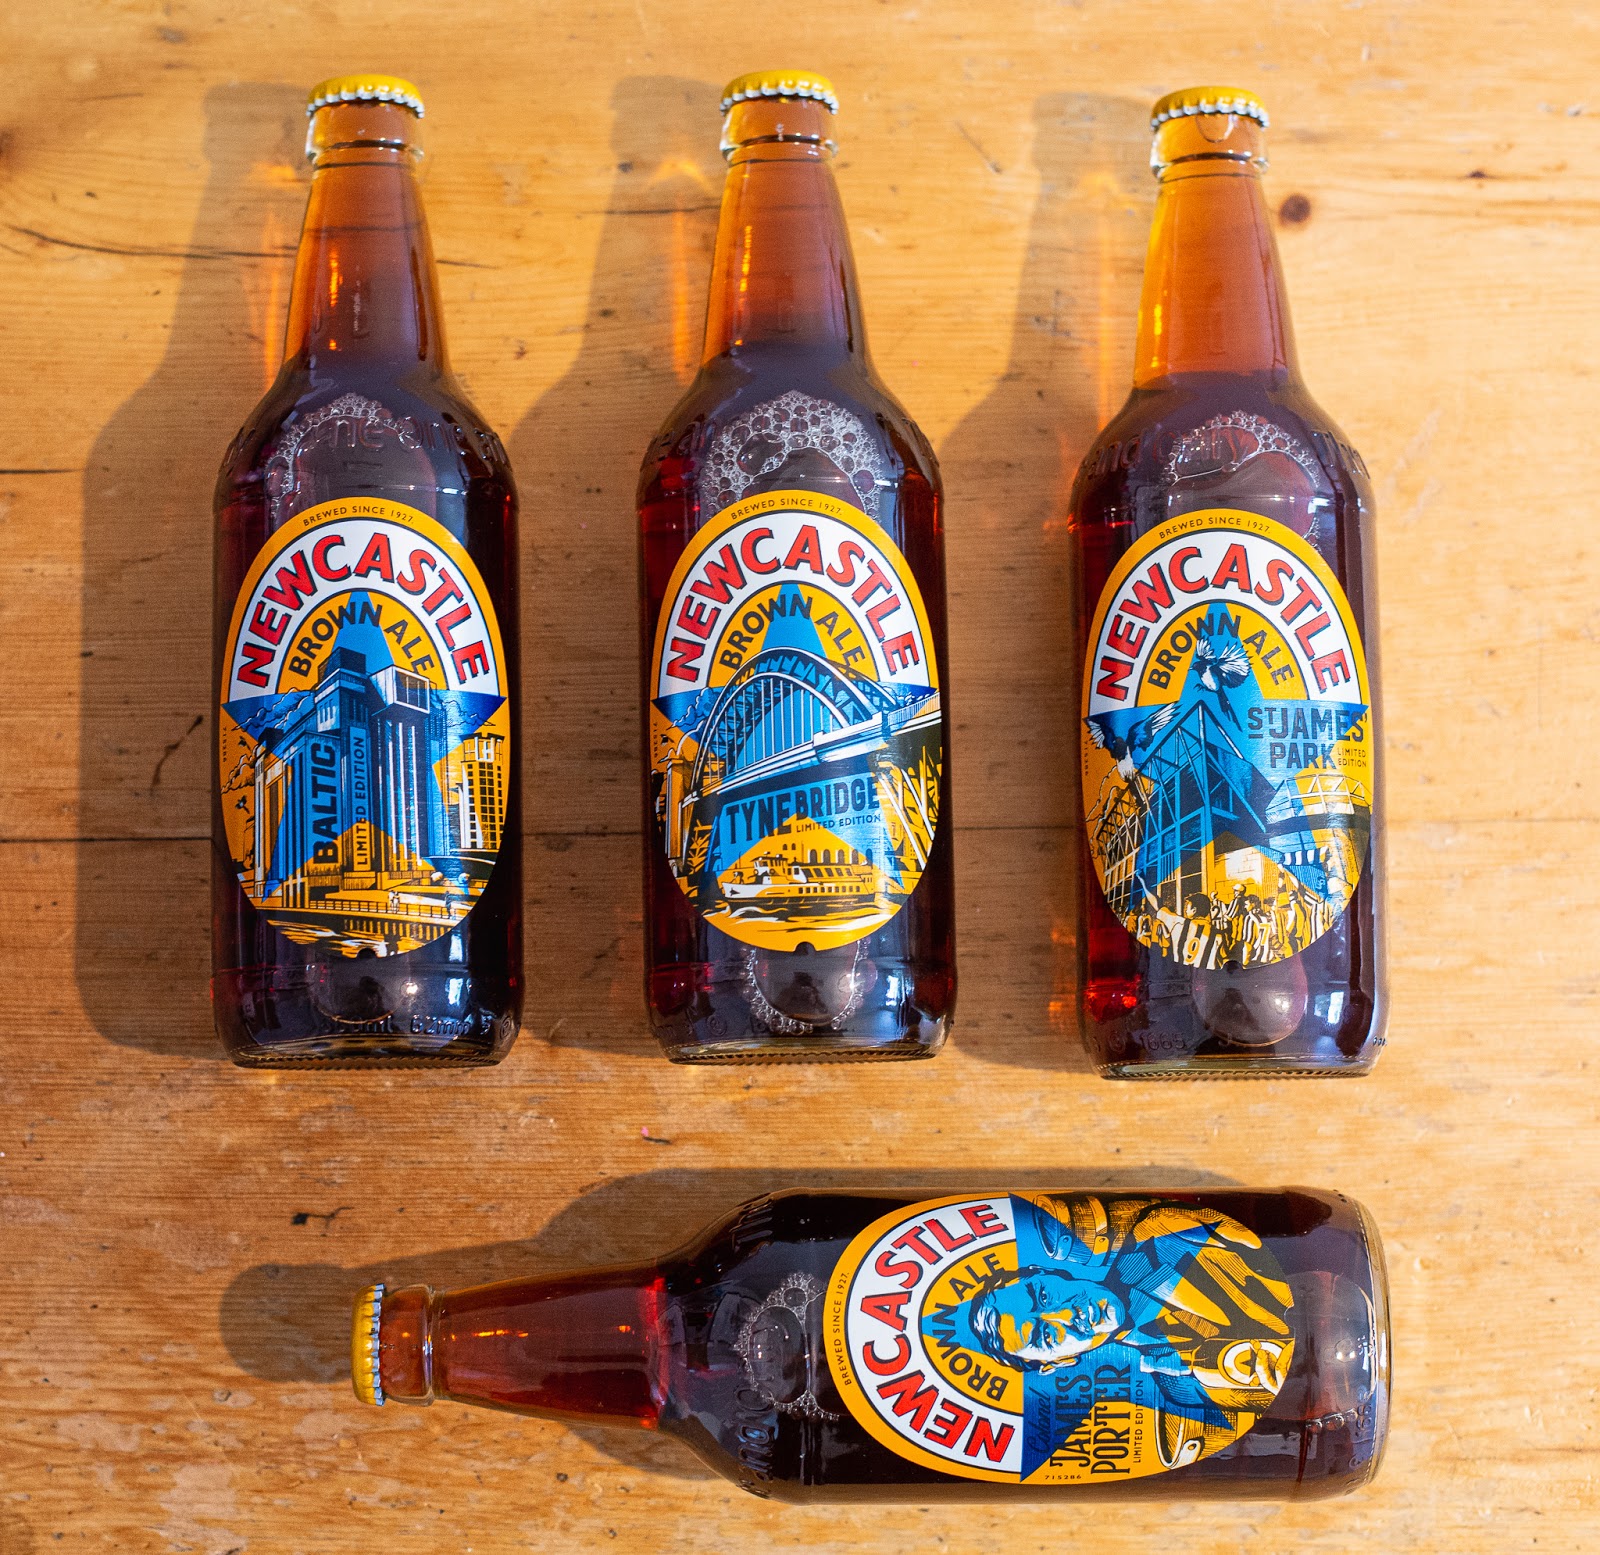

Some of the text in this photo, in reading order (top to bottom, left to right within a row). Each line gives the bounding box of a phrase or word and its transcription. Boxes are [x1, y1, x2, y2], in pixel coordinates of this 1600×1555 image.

[303, 507, 347, 526] BREWED
[352, 506, 385, 515] SINCE
[731, 500, 775, 520] BREWED
[781, 498, 813, 507] SINCE
[1159, 518, 1203, 539] BREWED
[1209, 517, 1241, 525] SINCE
[236, 532, 490, 688] NEWCASTLE
[289, 601, 435, 678] BROWN ALE
[666, 524, 920, 682] NEWCASTLE
[719, 593, 867, 670] BROWN ALE
[1096, 543, 1350, 702] NEWCASTLE
[1147, 612, 1295, 690] BROWN ALE
[1270, 742, 1336, 769] PARK
[1337, 748, 1366, 757] LIMITED
[1338, 758, 1366, 768] EDITION
[311, 742, 339, 864] BALTIC
[353, 736, 368, 866] LIMITED EDITION
[726, 776, 880, 845] TYNE BRIDGE
[796, 812, 881, 833] LIMITED EDITION
[833, 1301, 842, 1333] SINCE
[860, 1203, 1015, 1463] NEWCASTLE
[932, 1252, 1009, 1402] BROWN ALE
[834, 1338, 852, 1386] BREWED
[1028, 1386, 1051, 1454] Colonel
[1049, 1374, 1093, 1468] JAMES
[1090, 1364, 1131, 1475] PORTER
[1133, 1380, 1144, 1464] LIMITED EDITION
